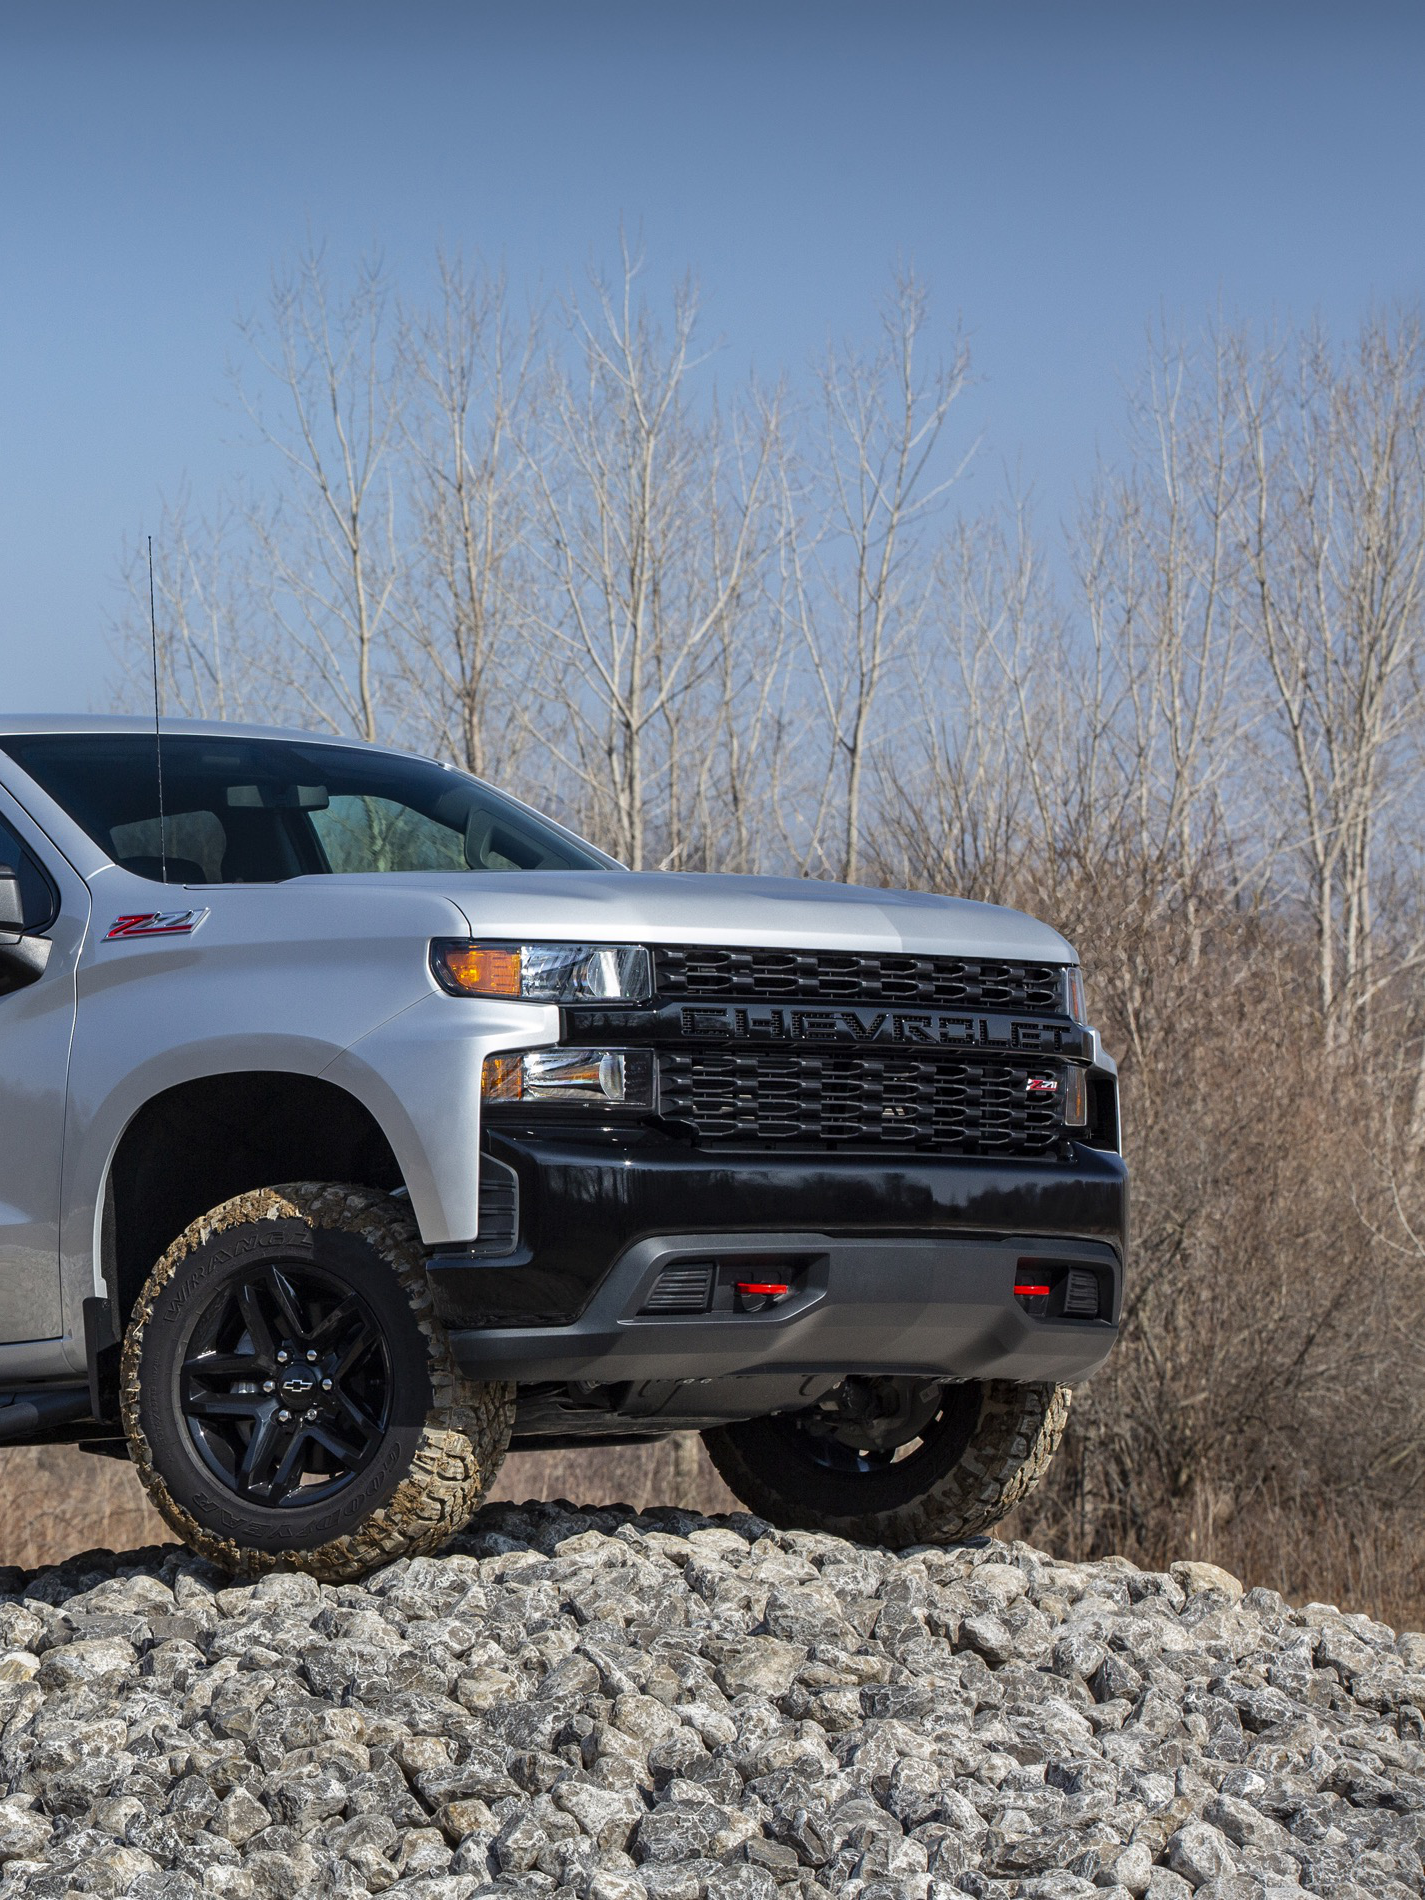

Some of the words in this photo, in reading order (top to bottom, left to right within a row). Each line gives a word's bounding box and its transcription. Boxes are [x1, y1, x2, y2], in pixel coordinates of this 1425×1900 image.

[101, 907, 211, 943] Z71
[681, 1005, 1072, 1052] CHEVROLET
[1026, 1078, 1058, 1092] Z71
[164, 1231, 314, 1322] WRANGL
[191, 1441, 403, 1540] GOODYEAR
